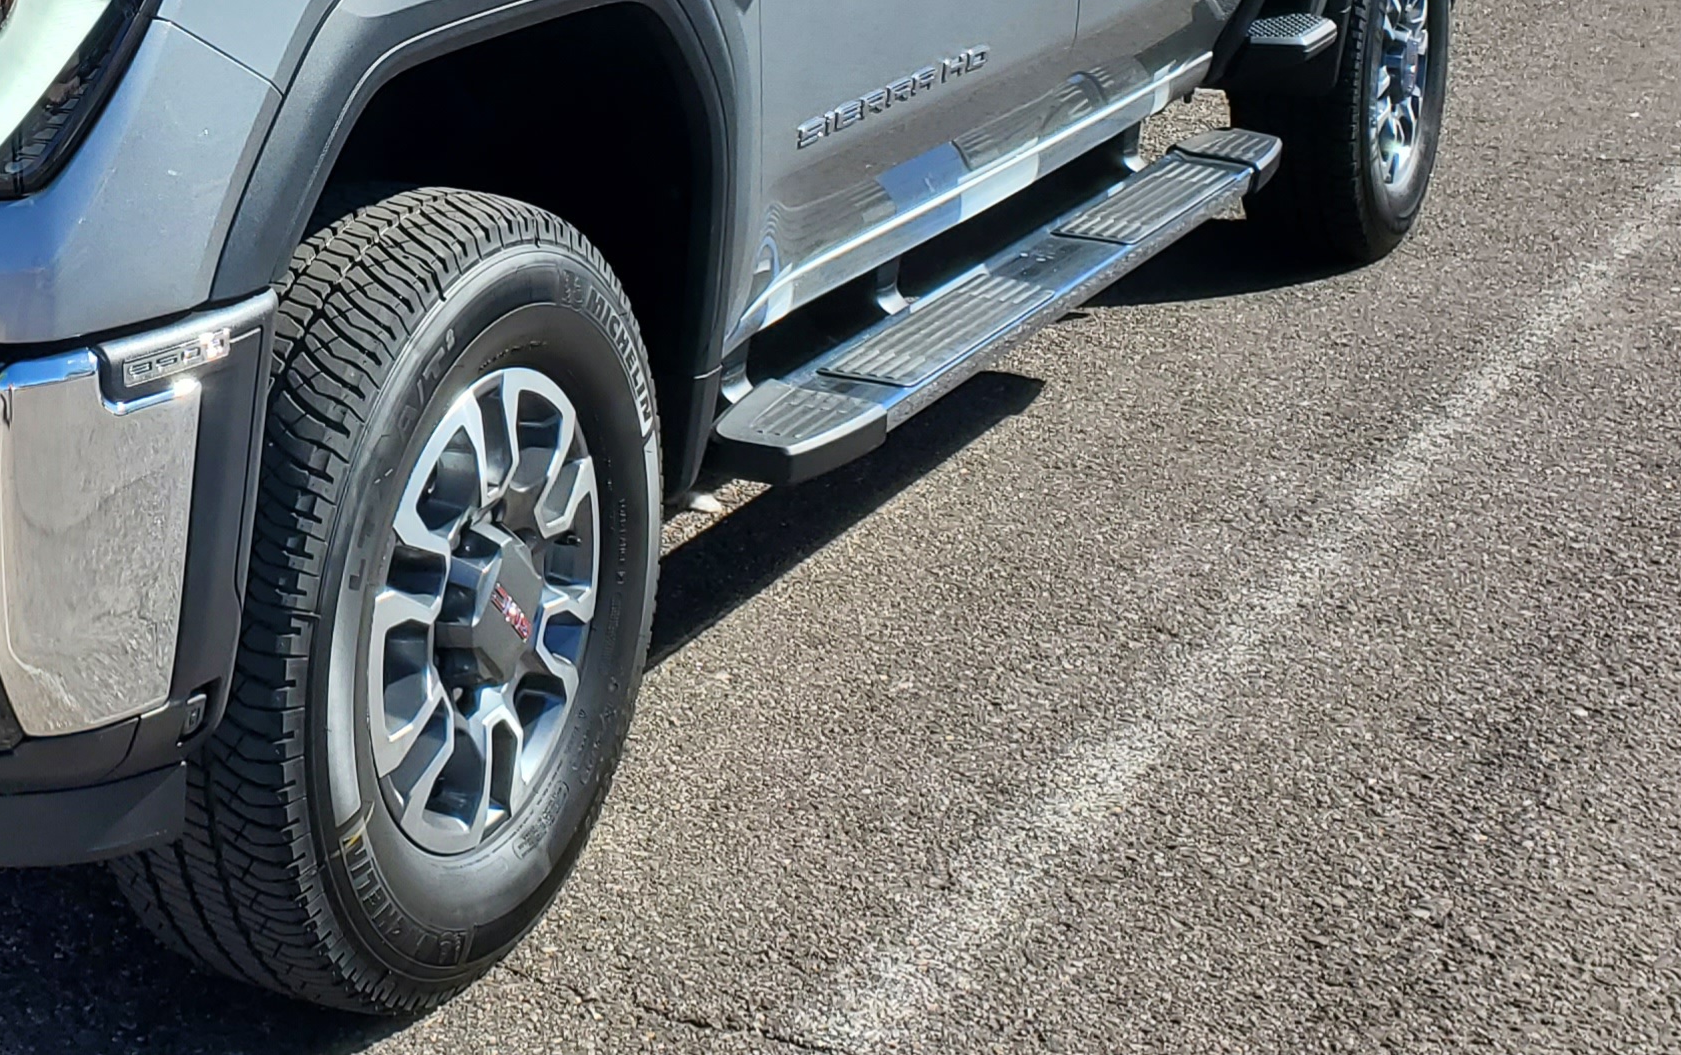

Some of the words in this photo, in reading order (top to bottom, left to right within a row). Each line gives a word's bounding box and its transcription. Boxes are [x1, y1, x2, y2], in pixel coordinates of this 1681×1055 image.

[796, 65, 937, 150] SIERRA
[939, 43, 991, 84] HD
[585, 287, 652, 423] MICHELIN
